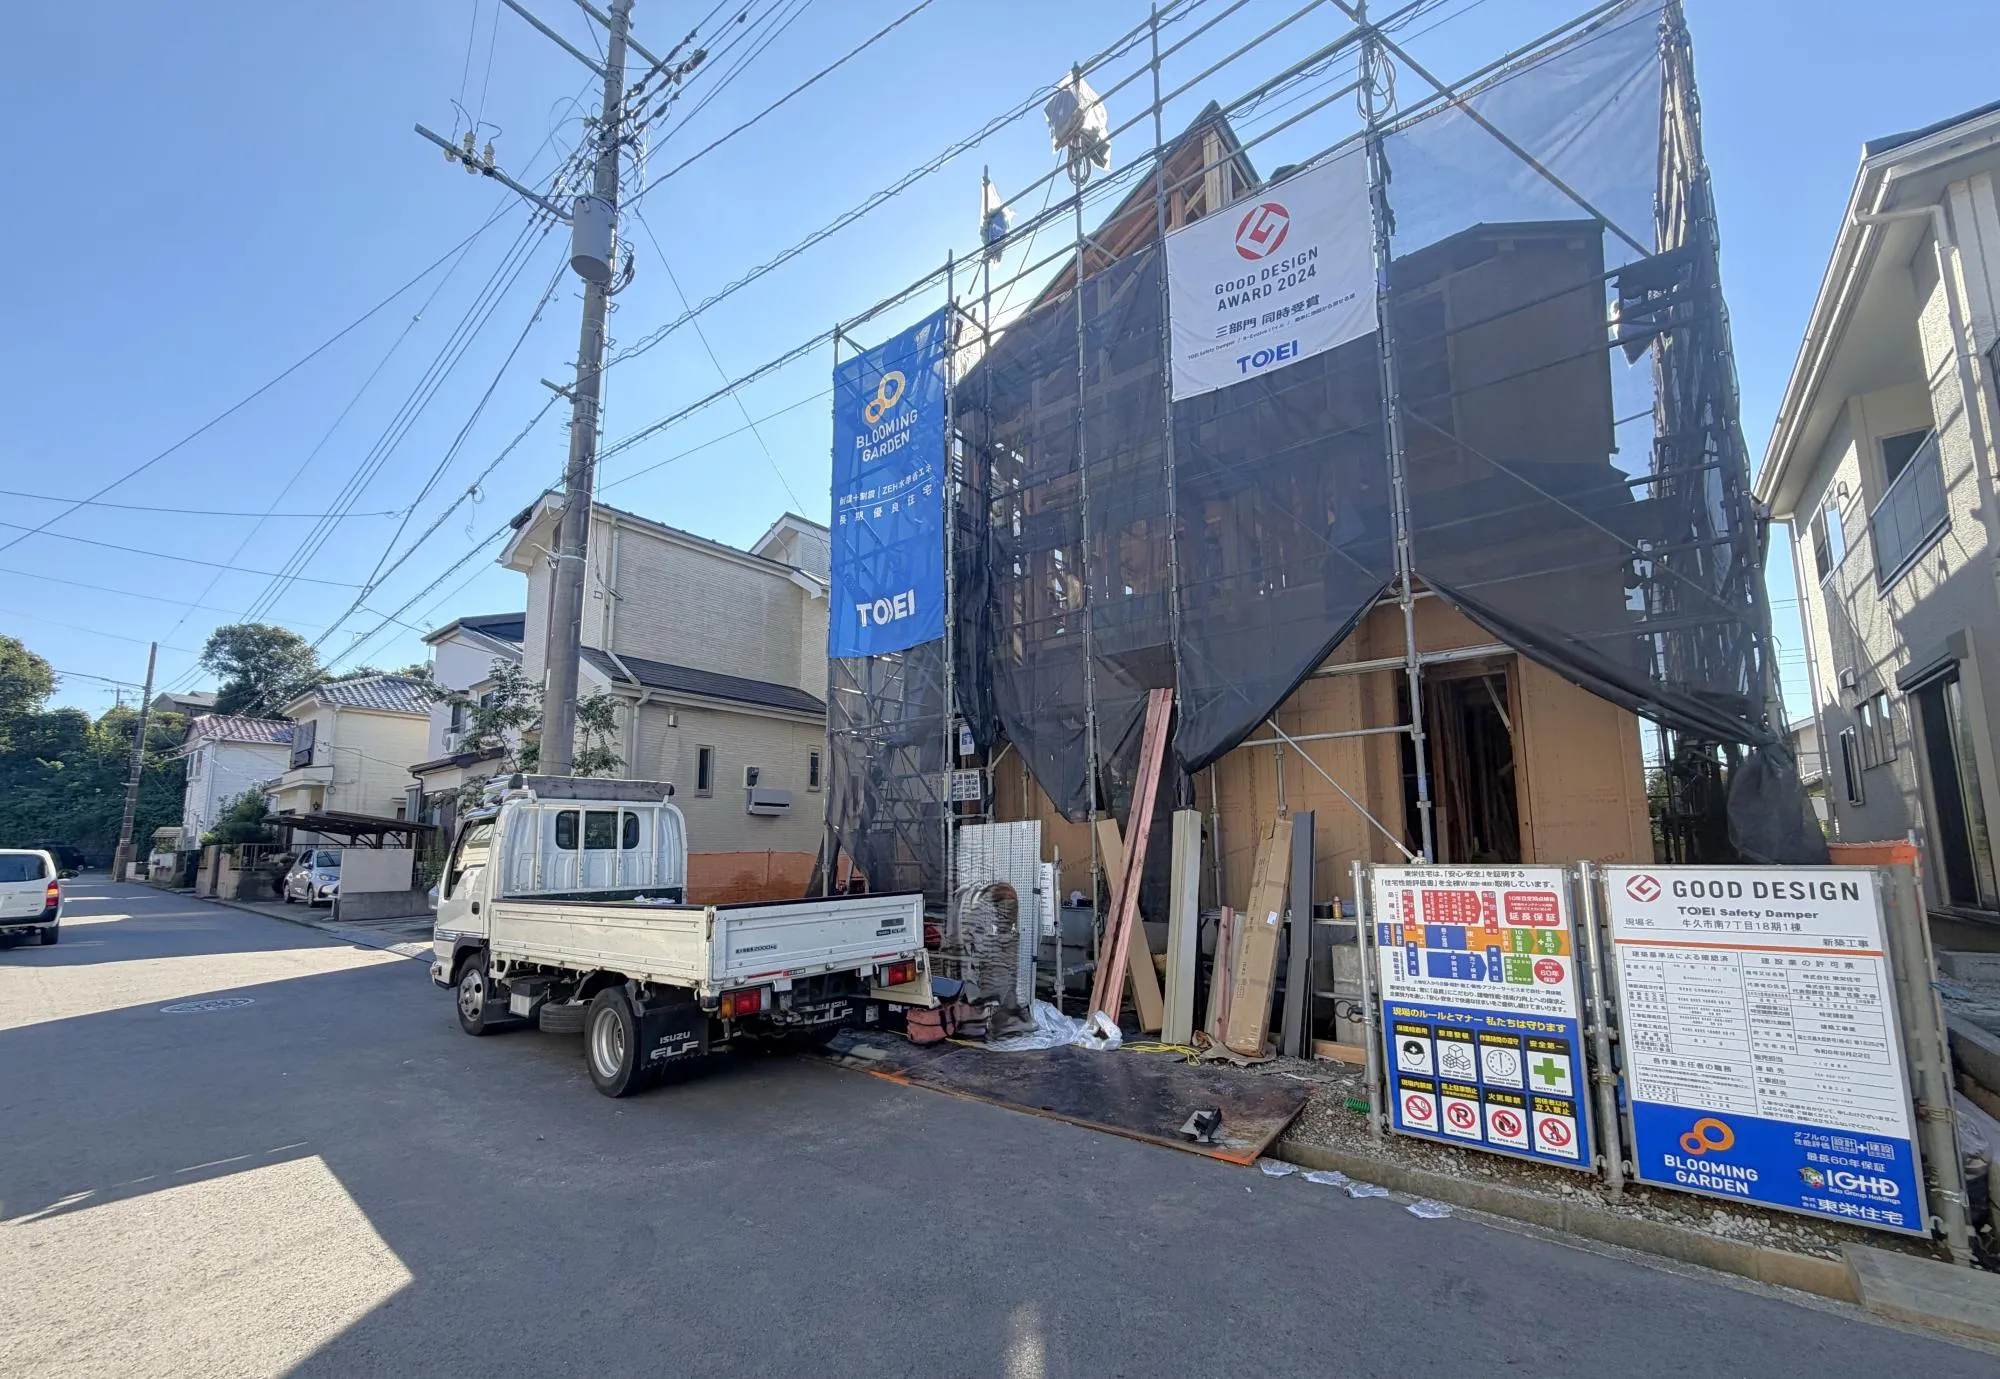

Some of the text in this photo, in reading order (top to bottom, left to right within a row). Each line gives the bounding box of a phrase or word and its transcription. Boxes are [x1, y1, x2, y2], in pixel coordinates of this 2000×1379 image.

[1215, 246, 1318, 295] GOOD DESIGN
[1217, 284, 1272, 312] AWARD
[1278, 263, 1316, 292] 2024
[1215, 317, 1257, 339] 三部門
[1262, 294, 1320, 326] 同時受賞
[1236, 340, 1298, 374] TOEI
[856, 409, 918, 449] BLOOMING
[862, 429, 910, 462] GARDEN
[856, 588, 915, 628] TOEI
[1673, 880, 1860, 901] GOOD DESIGN
[1509, 912, 1556, 922] 延長保証
[1677, 906, 1819, 920] TOEI Safety Damper
[1625, 917, 1802, 932] 現場名 牛久市南7丁目18期1棟
[1823, 938, 1869, 948] 新築工事
[1761, 958, 1854, 969] 建設業の許可票
[1392, 1006, 1567, 1033] 現場のルールとマナー 私たちは守ります
[660, 1031, 691, 1045] ISUZU
[1529, 1040, 1565, 1049] 安全第一
[650, 1040, 700, 1060] ELF
[1488, 1093, 1521, 1105] 火気厳禁
[1535, 1104, 1571, 1116] 立入禁止
[1794, 1131, 1829, 1142] ダブルの
[1663, 1153, 1759, 1182] BLOOMING
[1806, 1152, 1887, 1173] 最長60年保証
[1675, 1170, 1750, 1195] GARDEN
[1817, 1198, 1904, 1225] 東栄住宅
